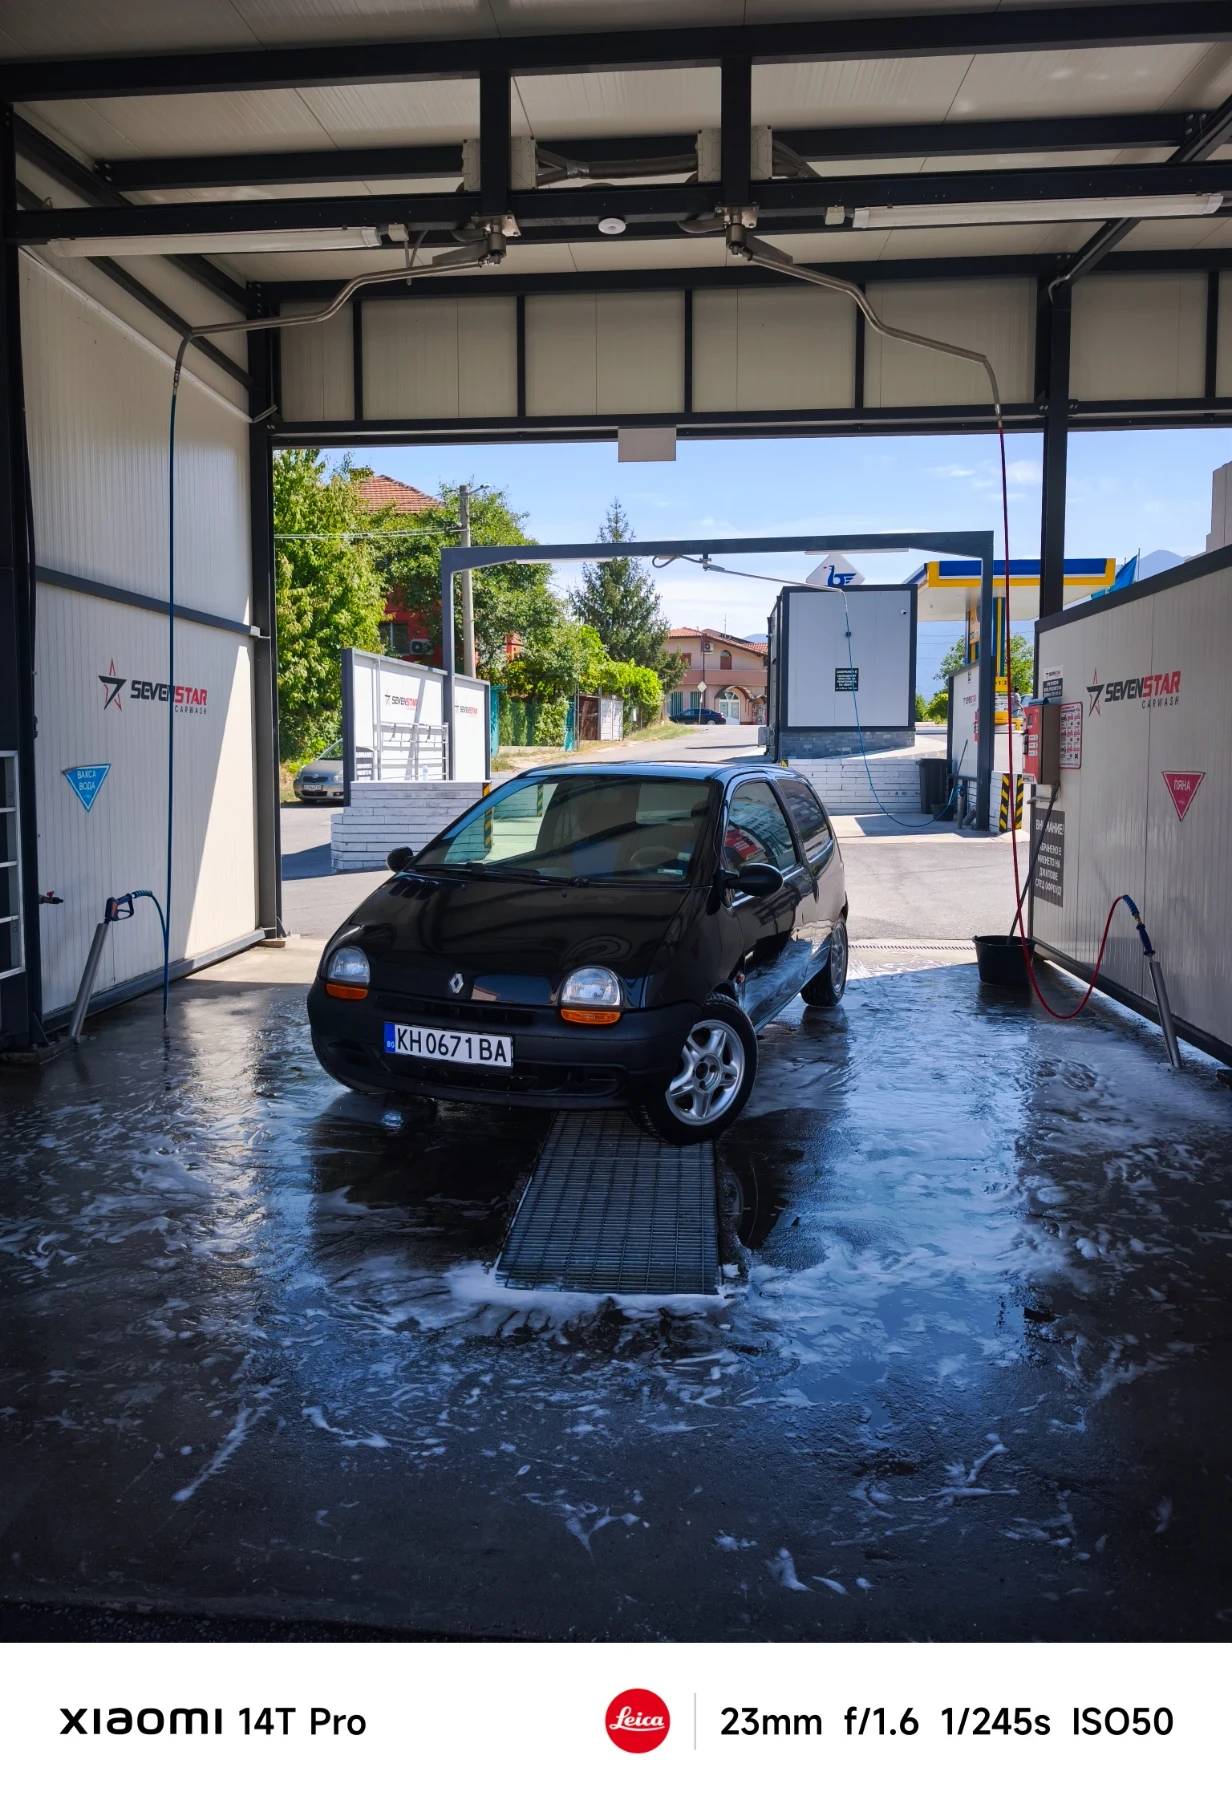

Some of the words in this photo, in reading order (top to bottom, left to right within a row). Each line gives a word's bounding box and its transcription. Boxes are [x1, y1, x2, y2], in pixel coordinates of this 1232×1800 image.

[130, 680, 207, 705] SEVENSTAR
[1104, 671, 1181, 702] SEVENSTAR
[1141, 696, 1180, 709] CARWASH
[174, 705, 208, 715] CARWASH
[77, 769, 96, 779] ВАКСА
[79, 781, 96, 791] ВОДА
[1173, 779, 1191, 791] ПЯНА
[1036, 819, 1064, 835] ВНМАНИЕ!
[1040, 842, 1059, 855] БРАНЕНО
[386, 1040, 395, 1049] BG
